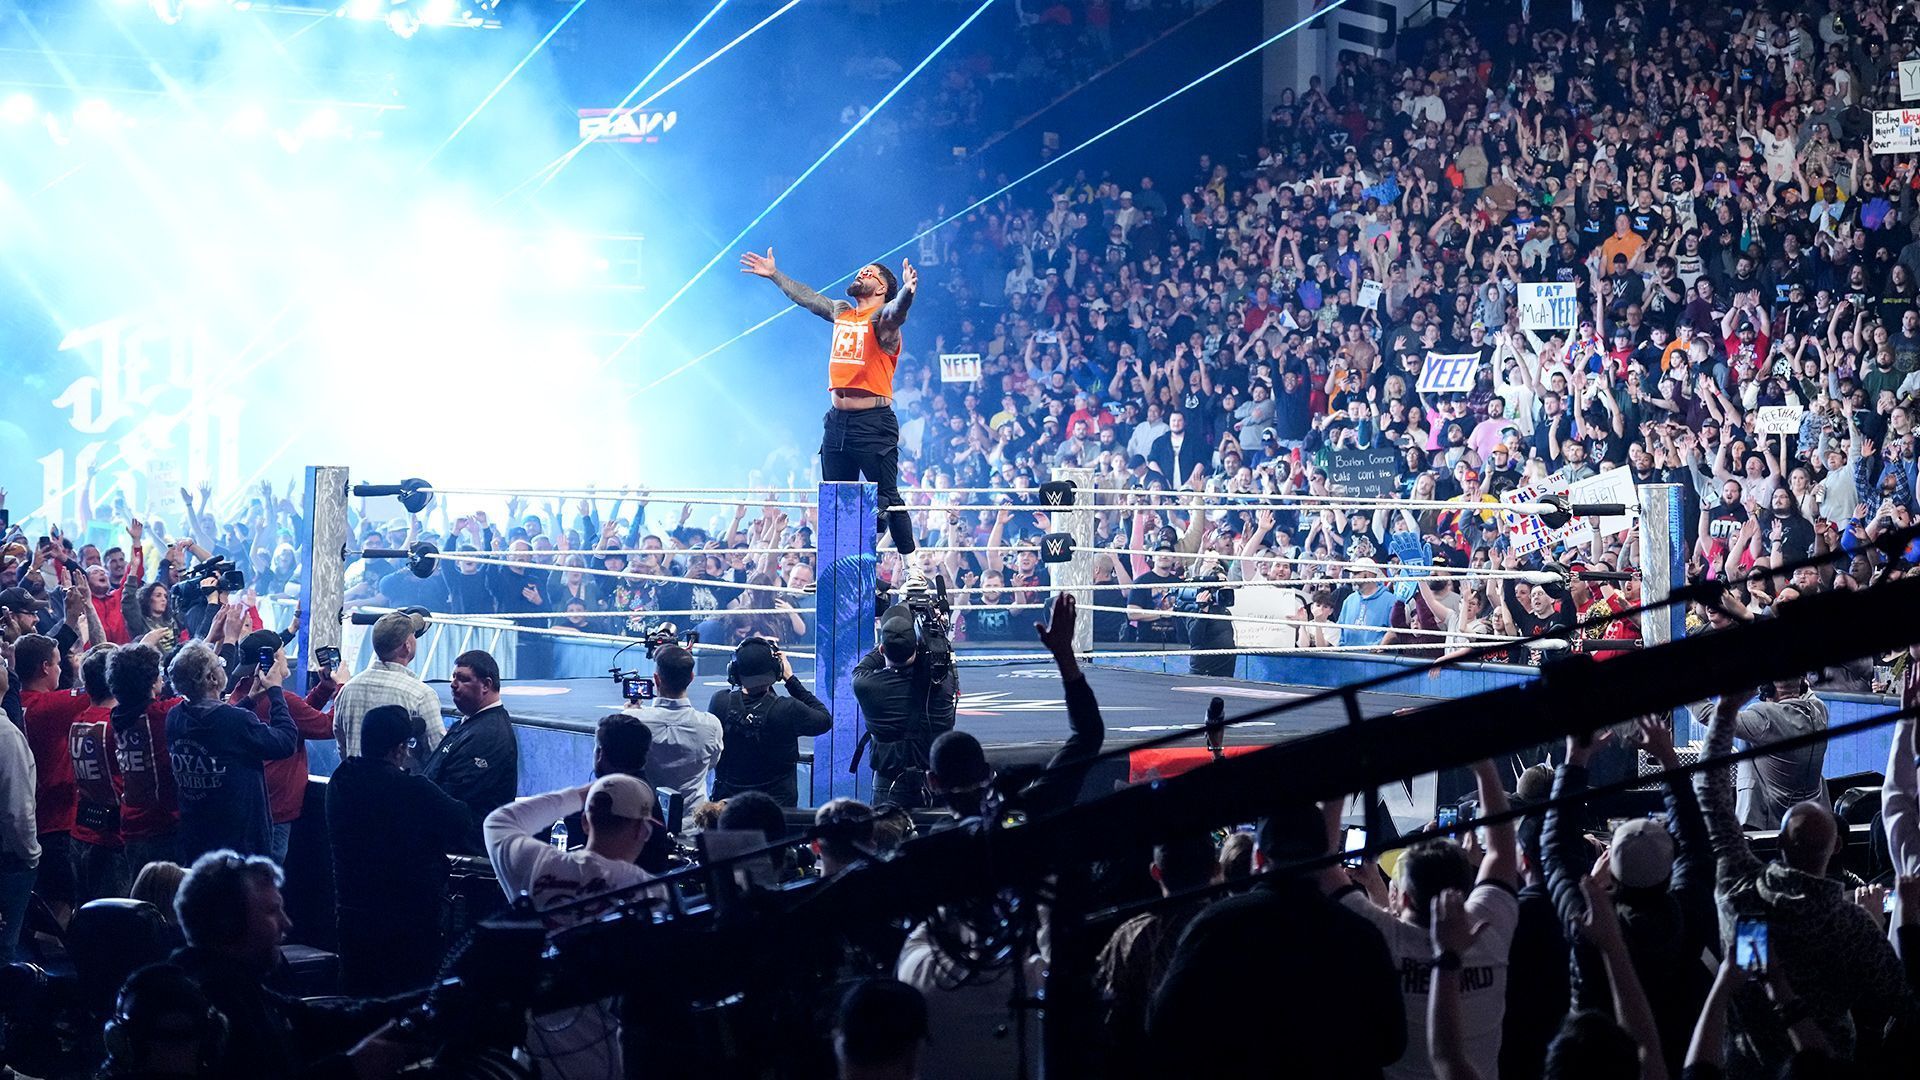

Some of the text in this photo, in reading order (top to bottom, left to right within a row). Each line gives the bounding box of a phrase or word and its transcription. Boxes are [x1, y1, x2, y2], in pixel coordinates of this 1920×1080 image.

[579, 111, 677, 138] RAW
[1537, 285, 1563, 297] PAT
[943, 357, 978, 377] YEET
[1423, 356, 1478, 388] YEET
[170, 752, 227, 774] OYAL
[174, 774, 223, 789] UMBLE
